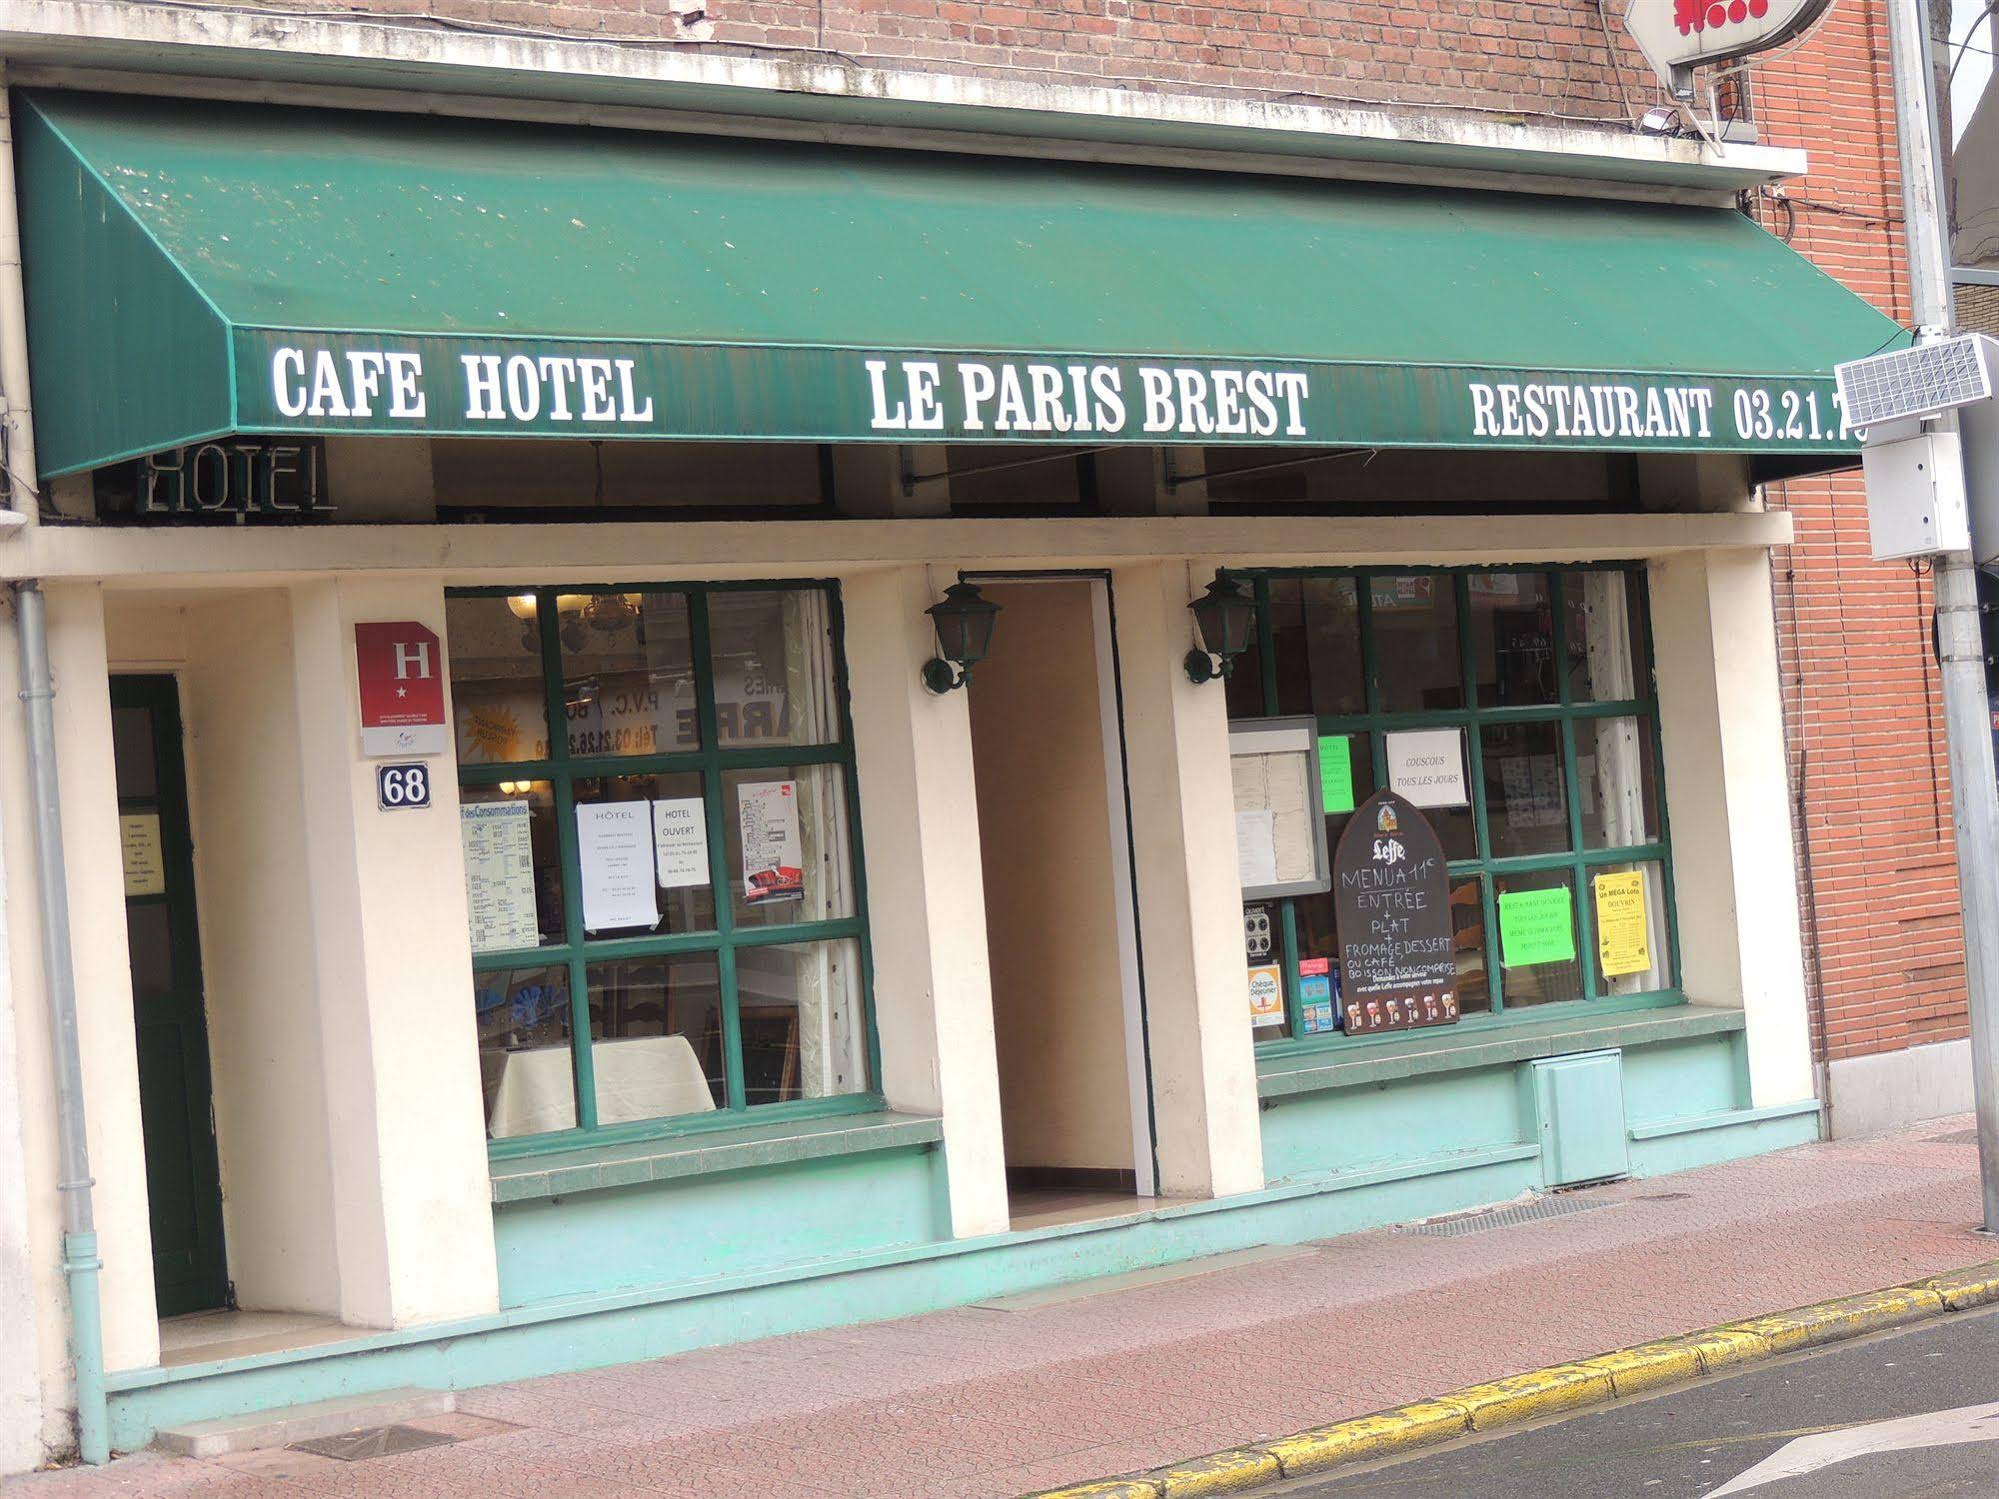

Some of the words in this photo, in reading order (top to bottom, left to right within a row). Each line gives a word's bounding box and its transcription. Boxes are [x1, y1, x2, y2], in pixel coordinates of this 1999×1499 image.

[272, 347, 426, 419] CAFE
[460, 354, 654, 423] HOTEL
[864, 360, 944, 430] LE
[957, 362, 1127, 433] PARIS
[1139, 366, 1309, 436] BREST
[1468, 383, 1713, 439] RESTAURANT
[1733, 388, 1869, 442] 03.21.7
[145, 444, 338, 512] HOTEL
[392, 641, 434, 680] H
[1405, 756, 1446, 767] COUSCOUS
[384, 768, 426, 804] 68
[1396, 777, 1418, 787] TOUS
[1418, 775, 1433, 785] LES
[1434, 774, 1459, 784] JOURS
[475, 803, 528, 817] Consommations
[665, 809, 691, 819] HOTEL
[662, 826, 695, 837] OUVERT
[1372, 838, 1406, 866] Leffe
[1342, 868, 1395, 889] MENU
[1357, 888, 1428, 910] ENTRÉE
[1371, 917, 1410, 934] PLAT
[1403, 937, 1451, 954] DESSERT
[1347, 959, 1361, 969] OU
[1348, 967, 1392, 979] BOISSON
[1394, 966, 1416, 977] NON
[1250, 986, 1276, 996] Déjeuner
[1251, 979, 1274, 988] Chèque
